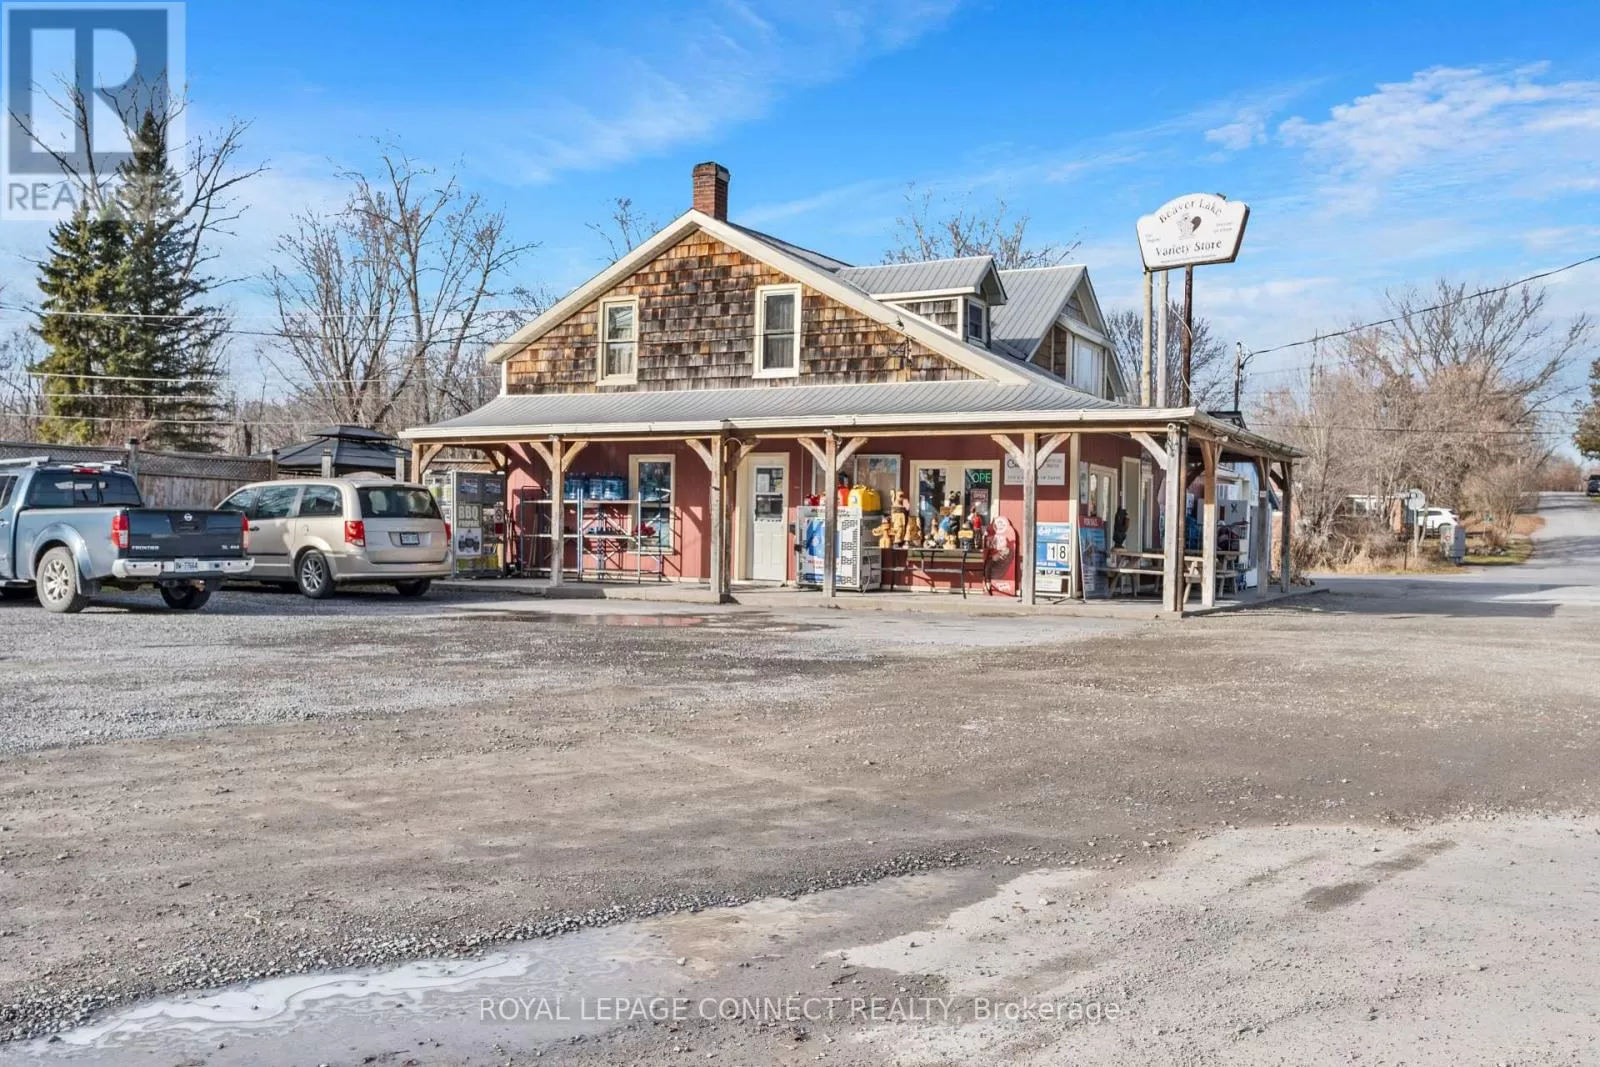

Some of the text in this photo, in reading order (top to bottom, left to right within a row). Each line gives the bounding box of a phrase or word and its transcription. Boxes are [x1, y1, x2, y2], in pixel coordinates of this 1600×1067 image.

[1159, 198, 1222, 224] Beaver Lake
[1155, 239, 1222, 257] Variety Store
[972, 472, 992, 484] OPE
[458, 505, 479, 520] BBQ
